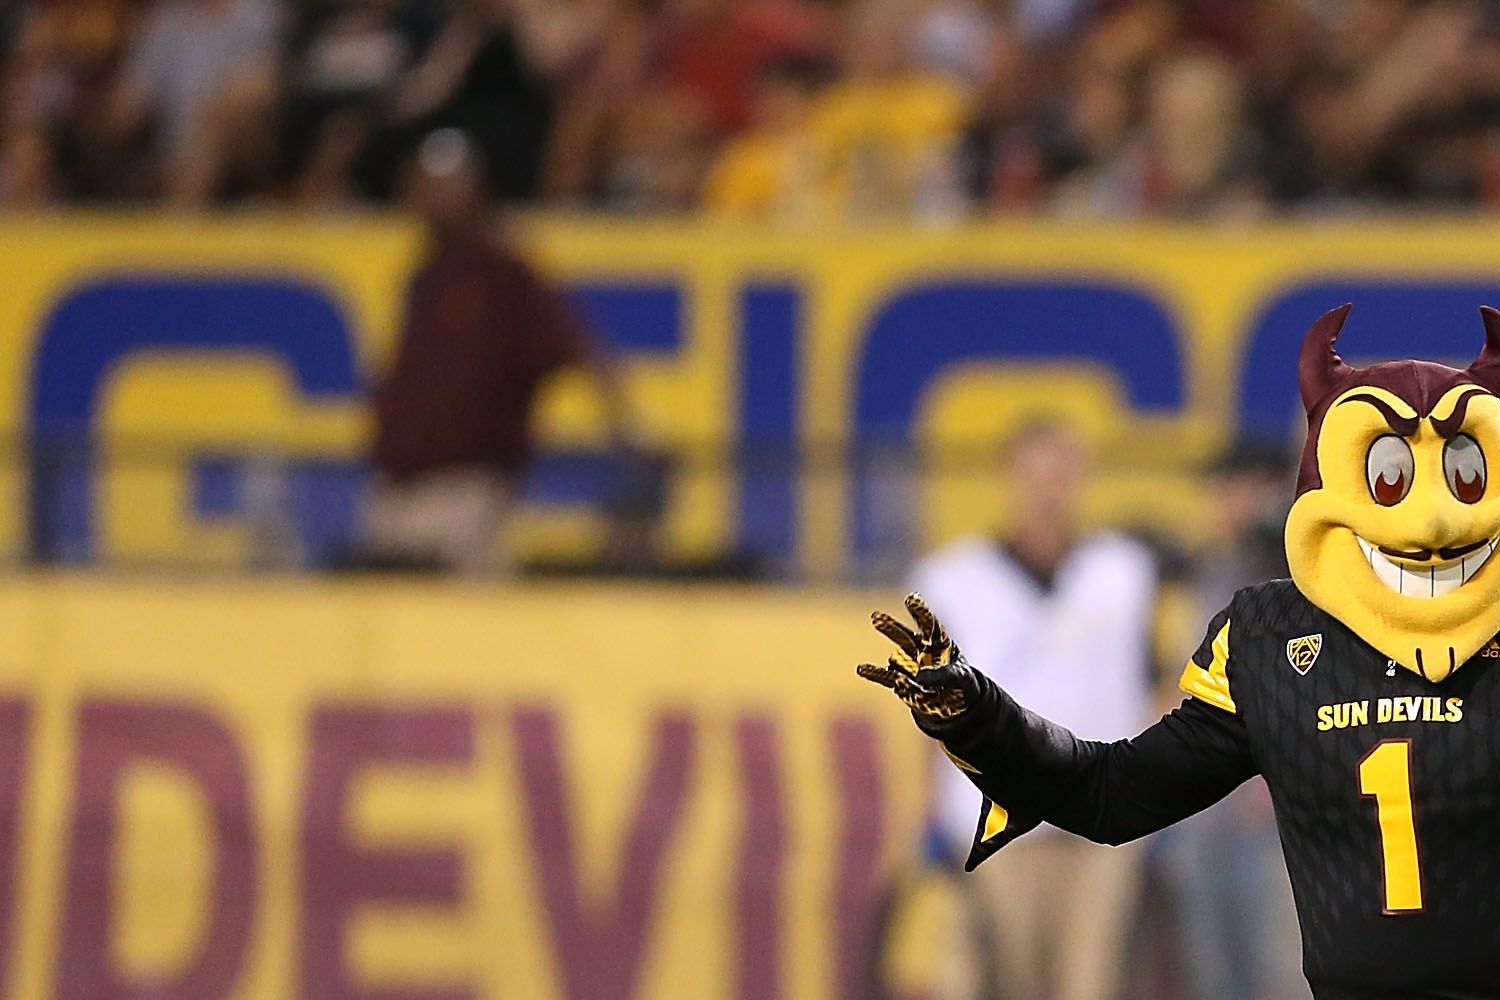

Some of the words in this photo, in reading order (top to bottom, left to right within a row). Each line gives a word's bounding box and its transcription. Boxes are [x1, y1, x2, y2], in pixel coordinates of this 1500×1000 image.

[1290, 636, 1319, 660] PAC
[1296, 650, 1311, 667] 12
[1317, 701, 1369, 731] SUN
[1377, 697, 1463, 723] DEVILS
[1357, 739, 1424, 914] 1
